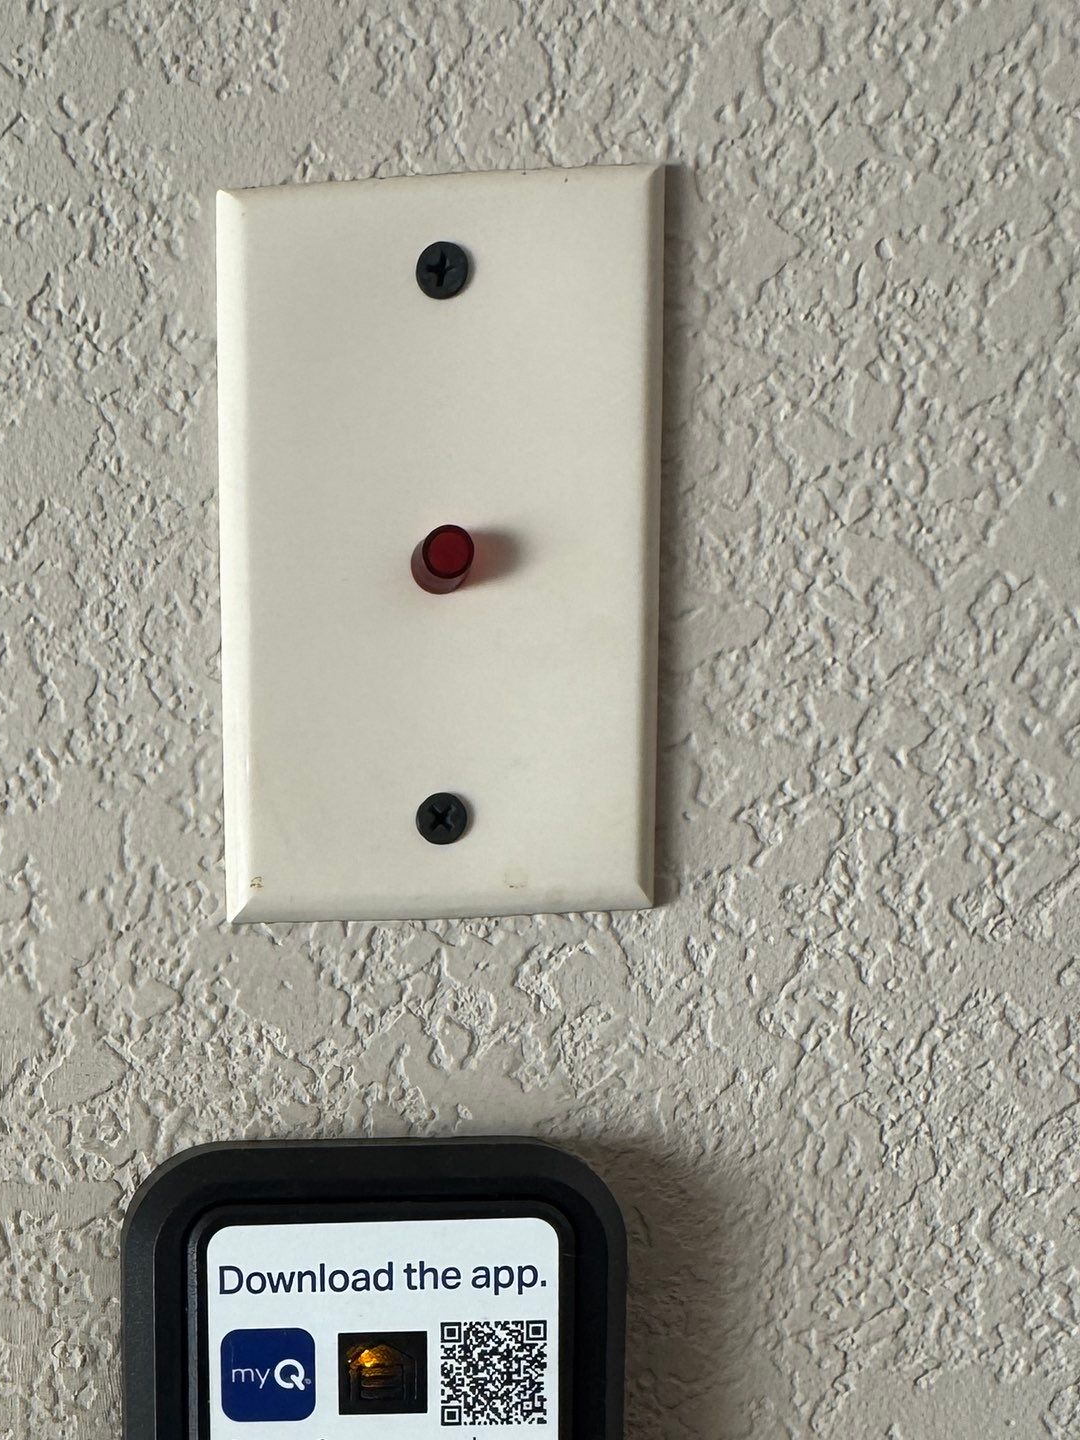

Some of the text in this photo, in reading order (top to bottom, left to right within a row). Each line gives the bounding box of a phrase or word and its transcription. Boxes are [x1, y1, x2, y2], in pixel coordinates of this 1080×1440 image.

[218, 1260, 547, 1295] Download the app.
